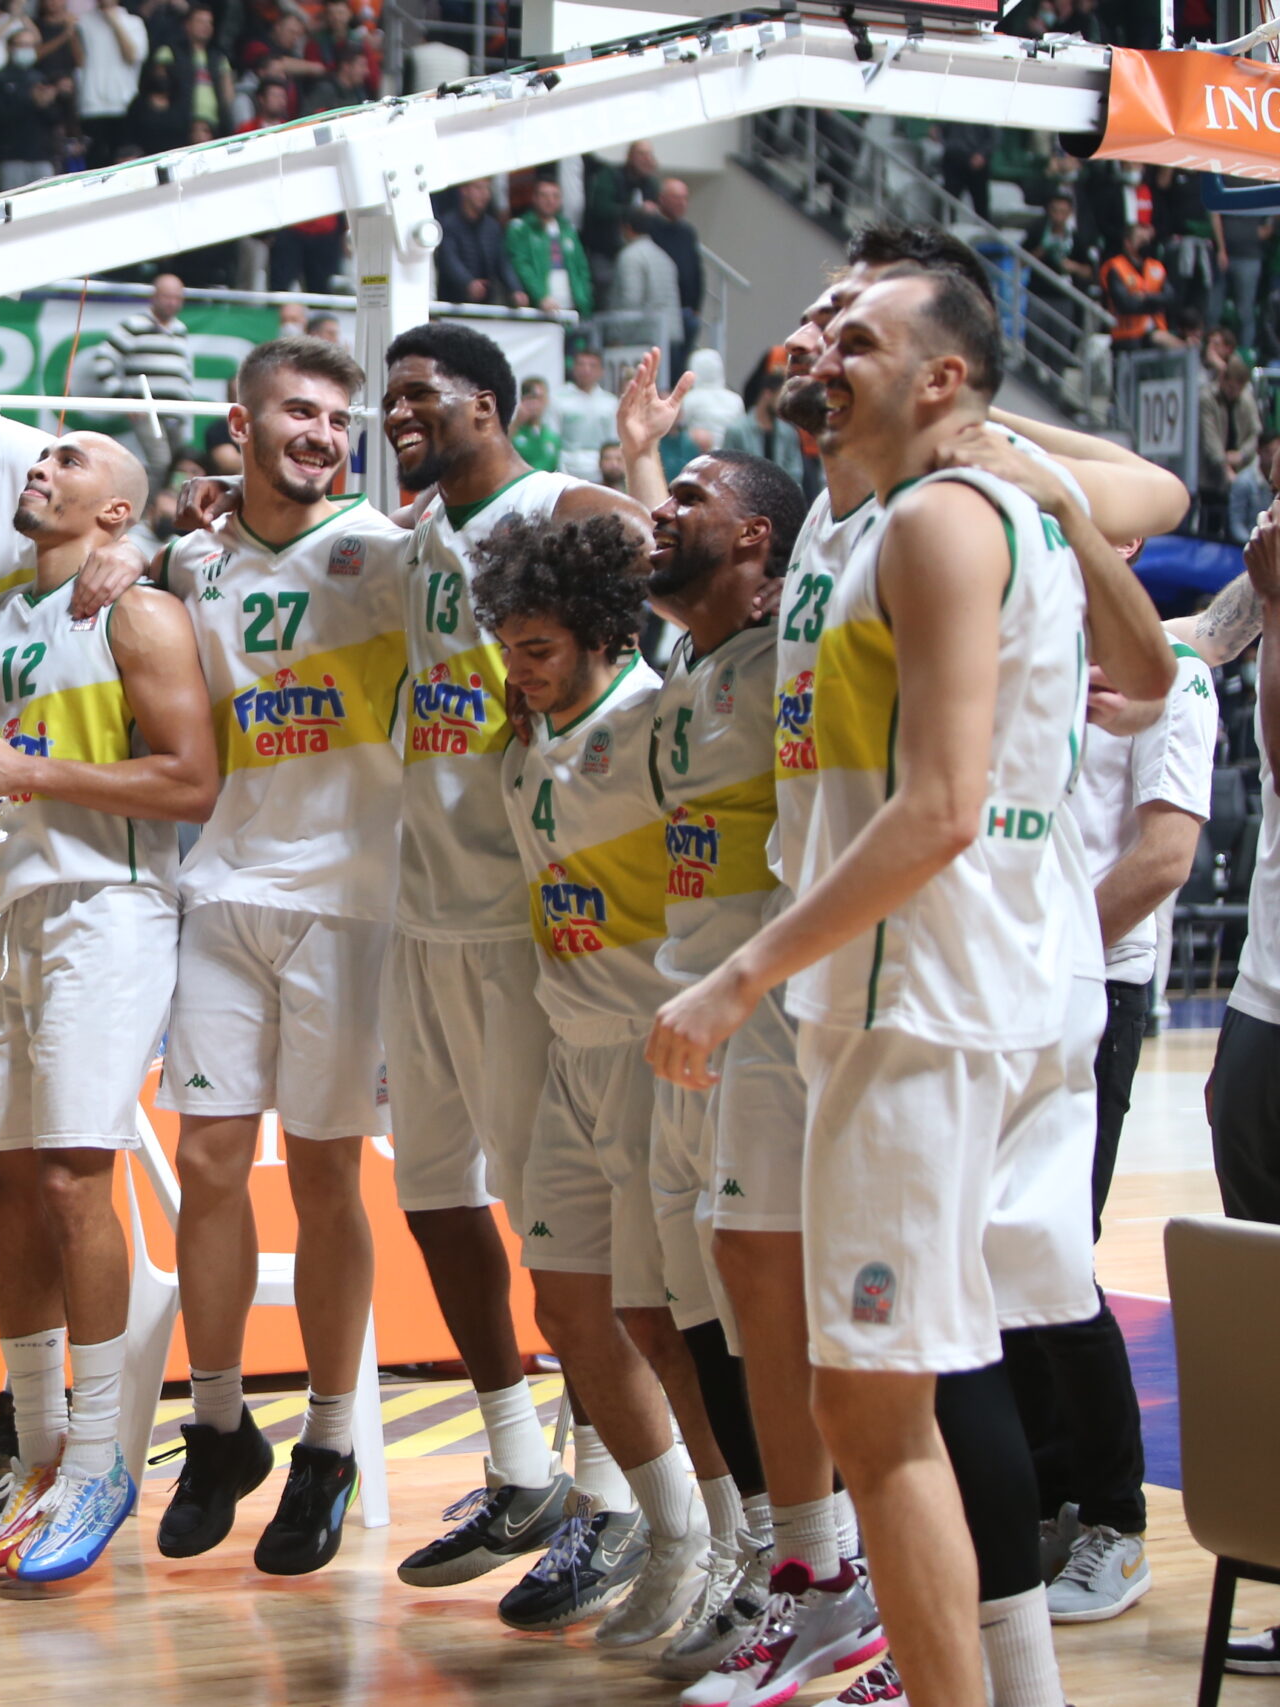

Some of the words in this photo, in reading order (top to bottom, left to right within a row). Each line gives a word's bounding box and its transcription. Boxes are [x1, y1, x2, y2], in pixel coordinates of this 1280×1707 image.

[1143, 390, 1179, 445] 109
[242, 591, 310, 654] 27
[426, 571, 463, 635] 13
[782, 572, 834, 643] 23
[2, 641, 47, 703] 12
[413, 674, 486, 722] RUTTi
[255, 725, 330, 756] extra
[412, 722, 469, 756] extra
[671, 706, 694, 775] 5
[778, 737, 818, 770] ext
[531, 778, 557, 843] 4
[666, 866, 705, 899] xtra
